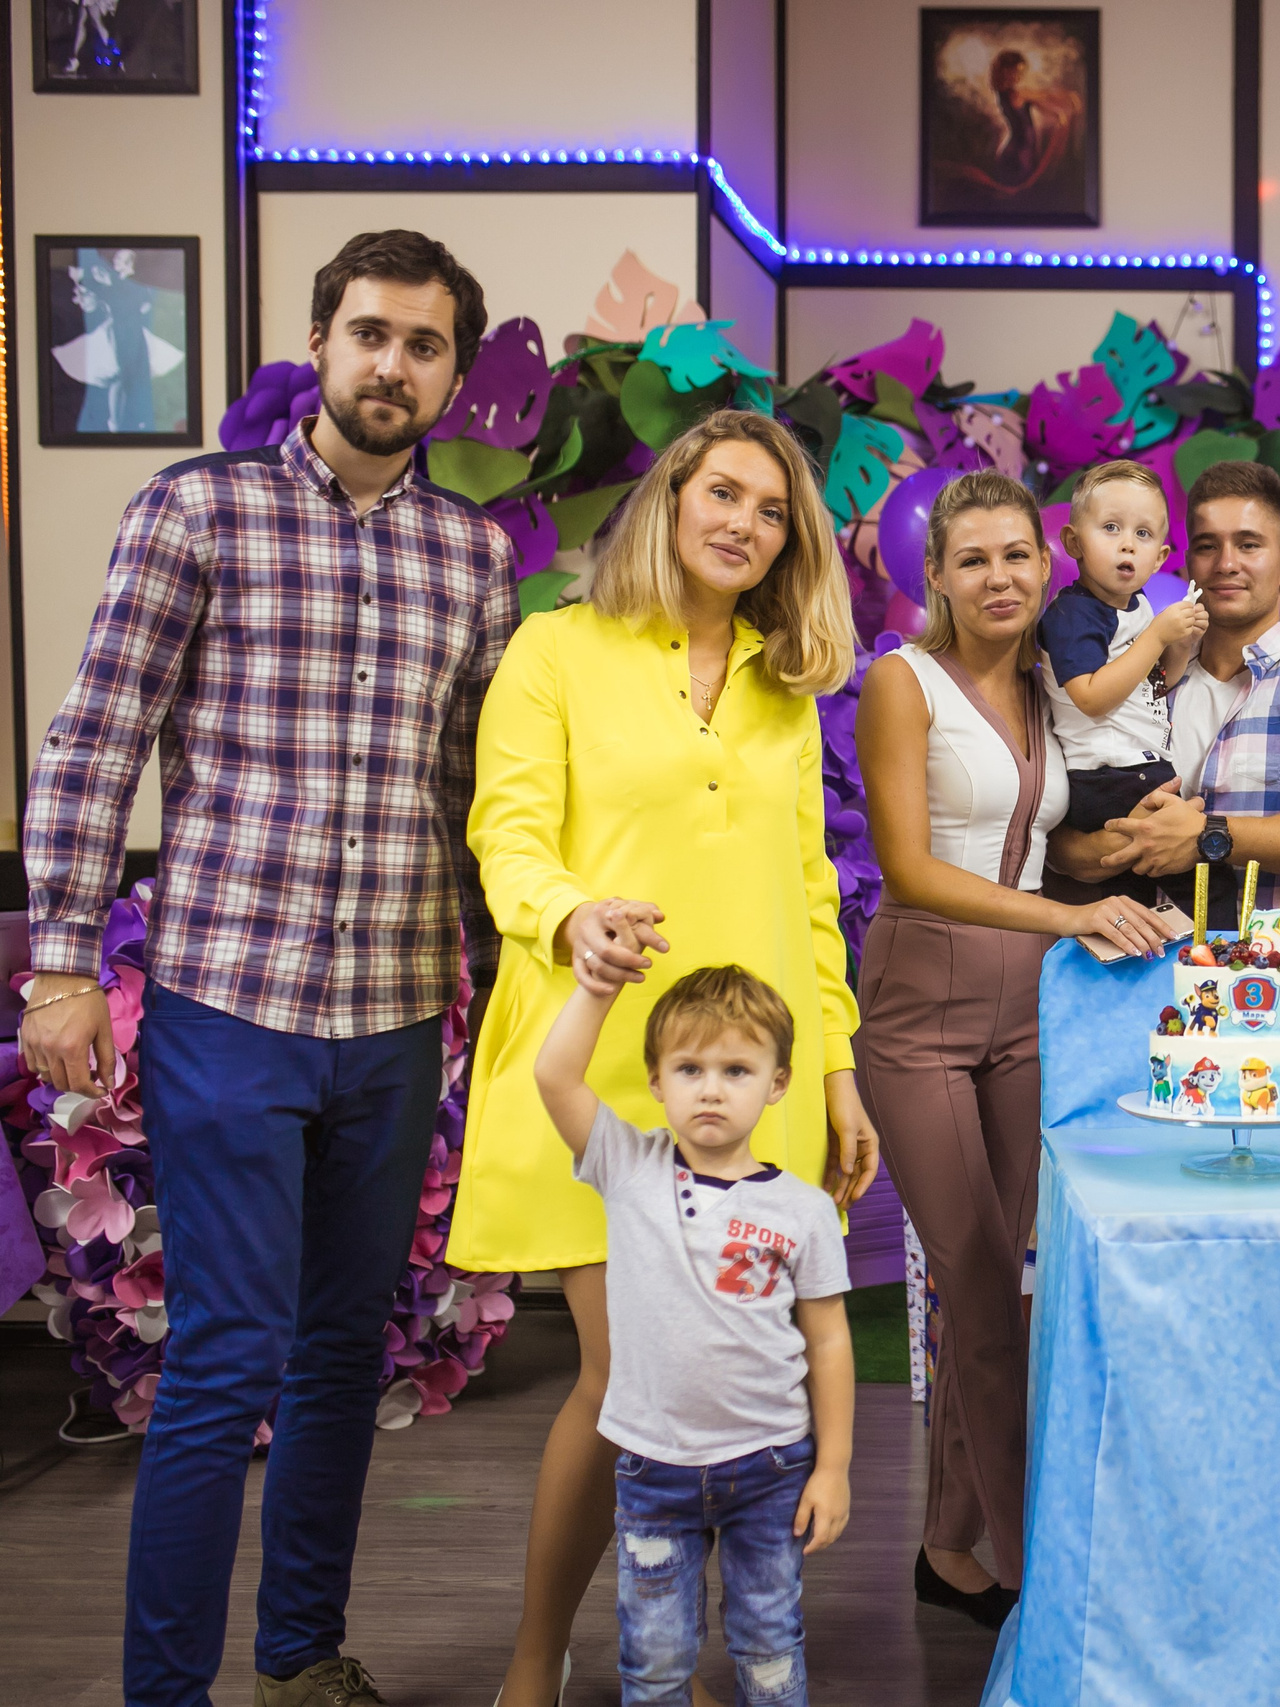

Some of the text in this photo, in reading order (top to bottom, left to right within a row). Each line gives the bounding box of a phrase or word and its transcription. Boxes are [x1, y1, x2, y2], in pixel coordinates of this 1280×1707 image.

[1245, 982, 1263, 1008] 3
[1242, 1011, 1266, 1020] Марк
[727, 1218, 797, 1260] SPORT
[715, 1240, 781, 1298] 27
